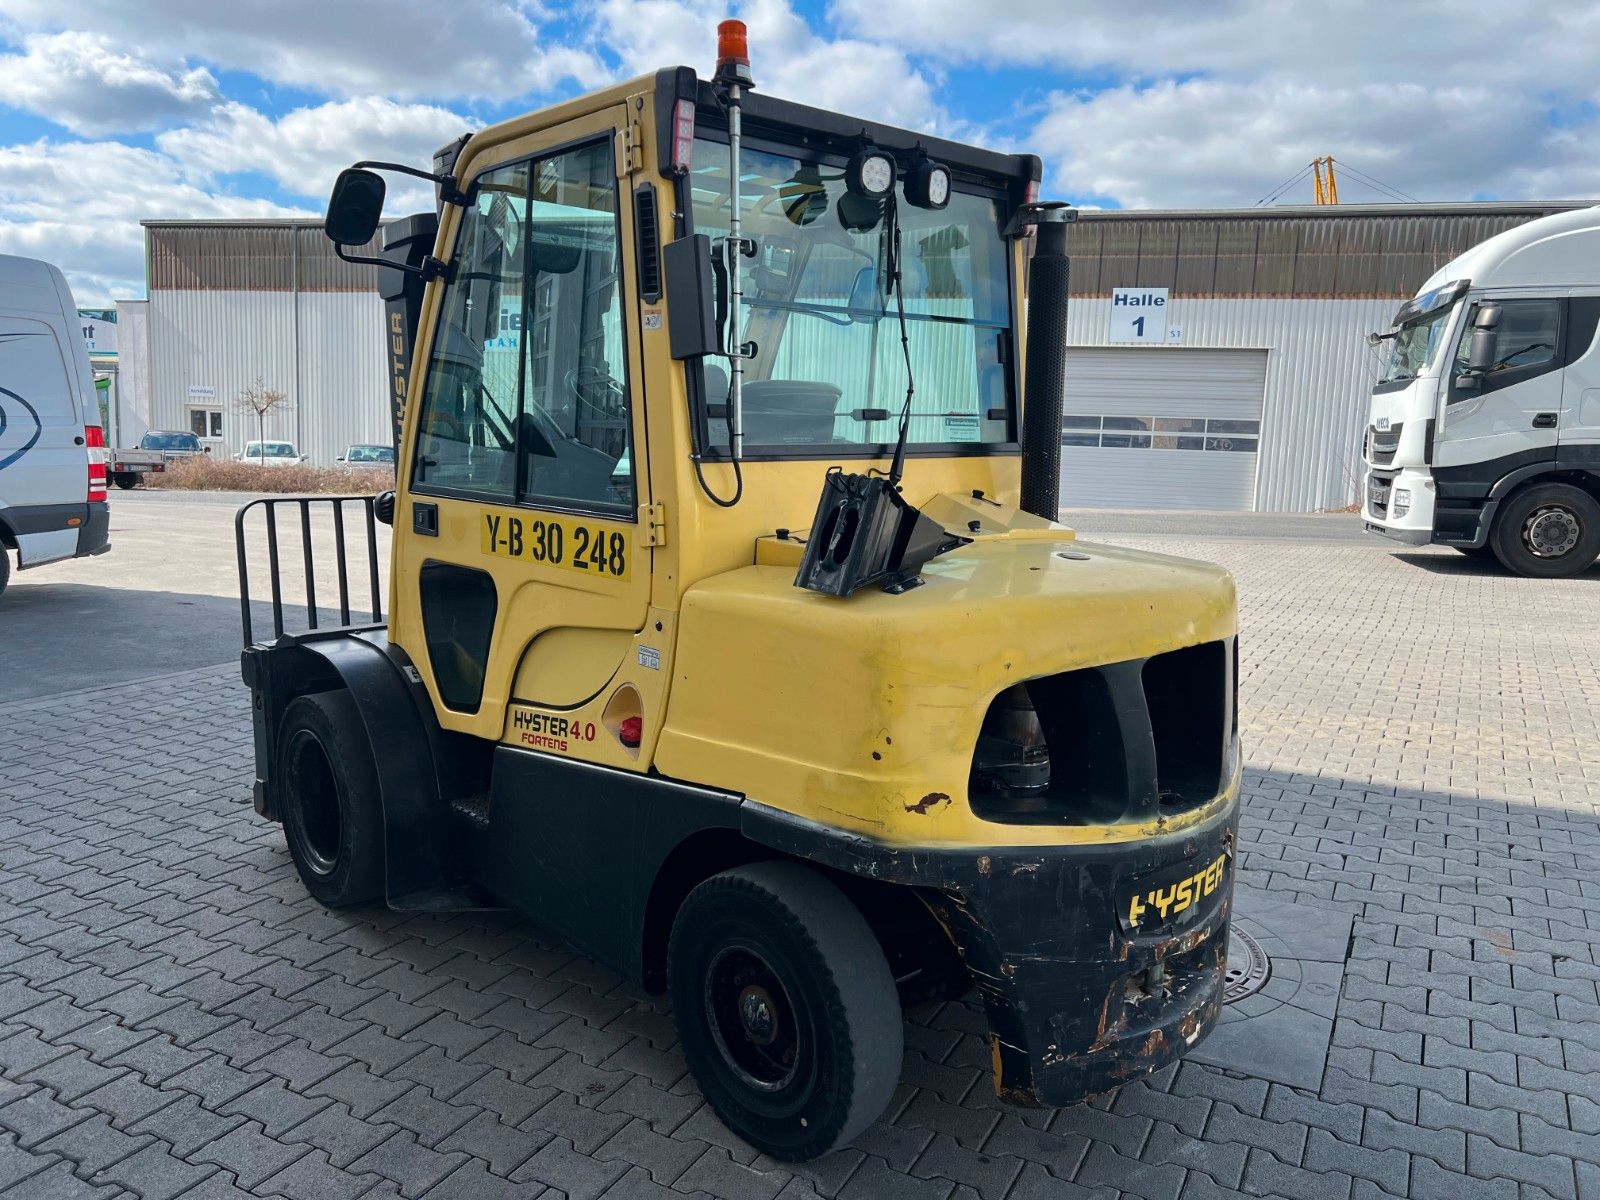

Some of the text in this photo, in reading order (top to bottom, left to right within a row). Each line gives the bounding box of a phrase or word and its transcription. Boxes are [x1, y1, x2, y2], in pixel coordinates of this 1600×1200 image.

[1114, 294, 1165, 306] Halle
[1132, 316, 1144, 337] 1
[391, 312, 407, 452] YSTER
[486, 514, 625, 576] Y-B 30 248
[514, 710, 596, 742] HYSTER 4.0
[521, 732, 567, 752] FORTENS
[1129, 853, 1226, 928] HYSTER
